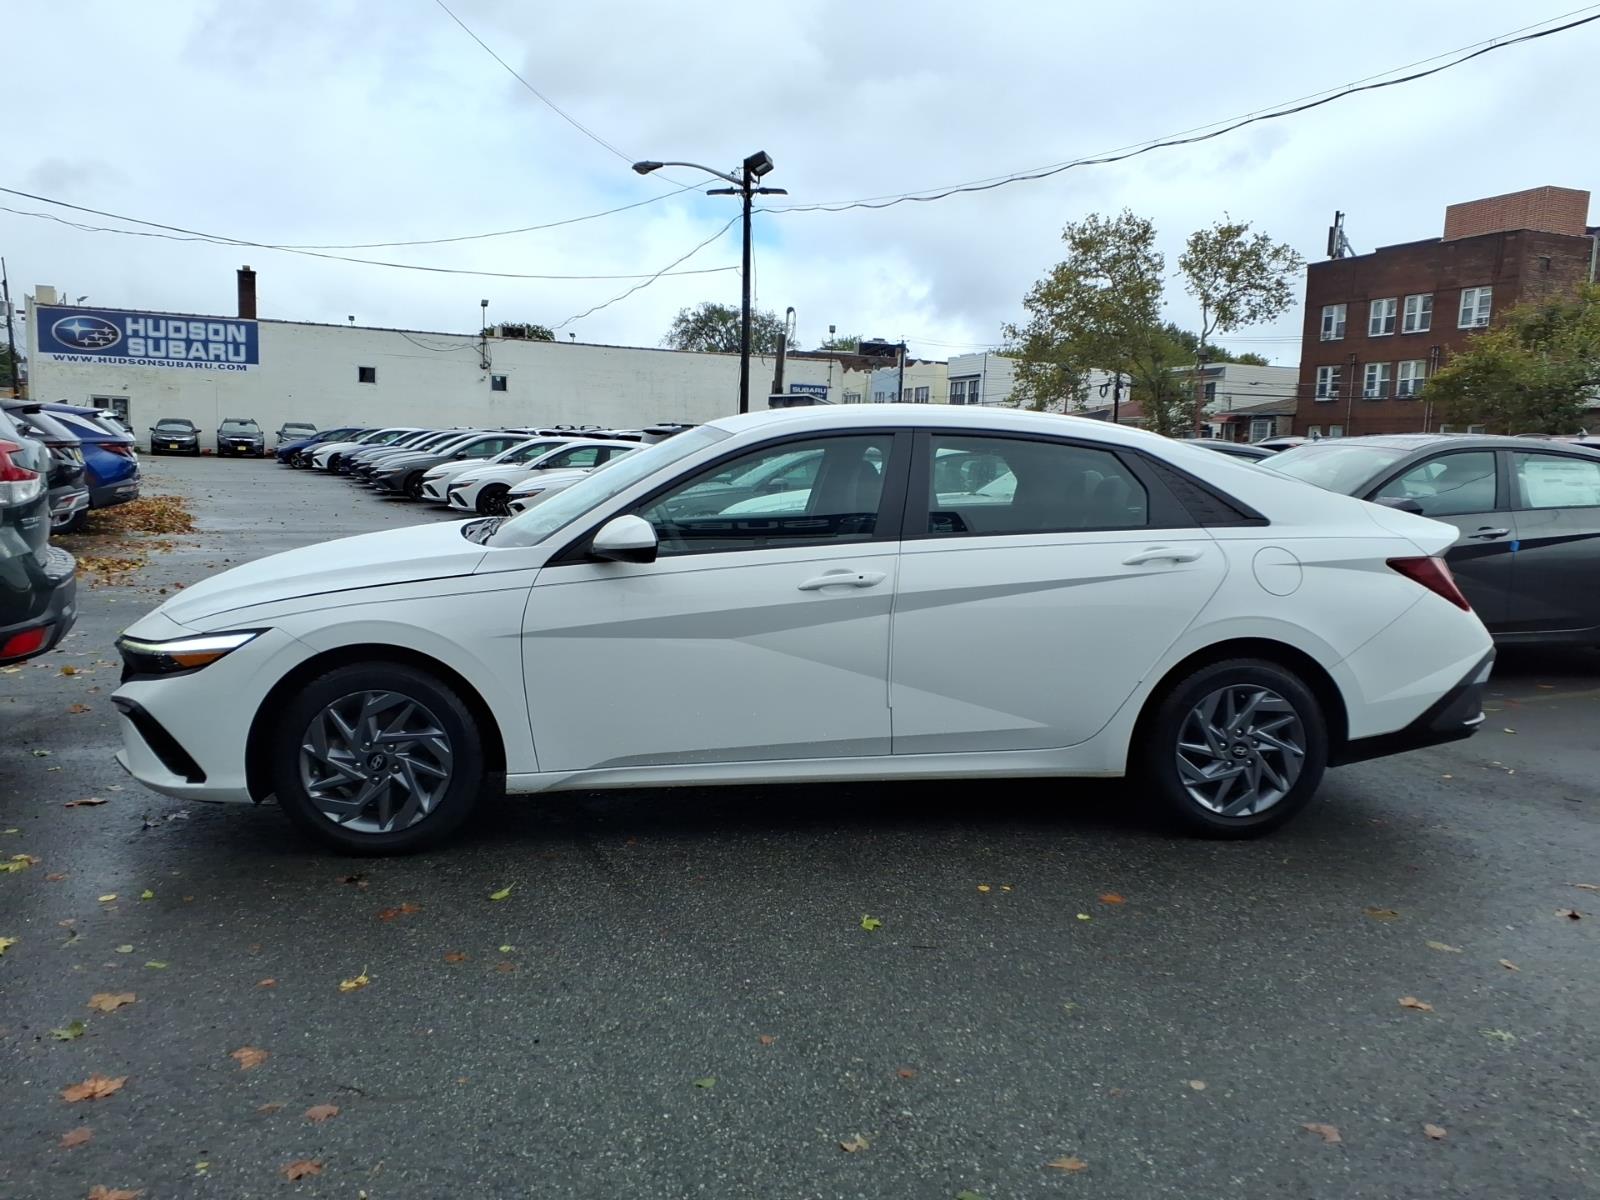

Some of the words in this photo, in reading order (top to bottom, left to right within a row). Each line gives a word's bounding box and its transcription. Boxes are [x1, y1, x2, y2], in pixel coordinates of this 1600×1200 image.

[125, 317, 247, 343] HUDSON
[127, 337, 246, 363] SUBARU
[52, 353, 248, 371] WWW.HUDSONSUBARU.COM
[792, 386, 827, 394] SUBARU
